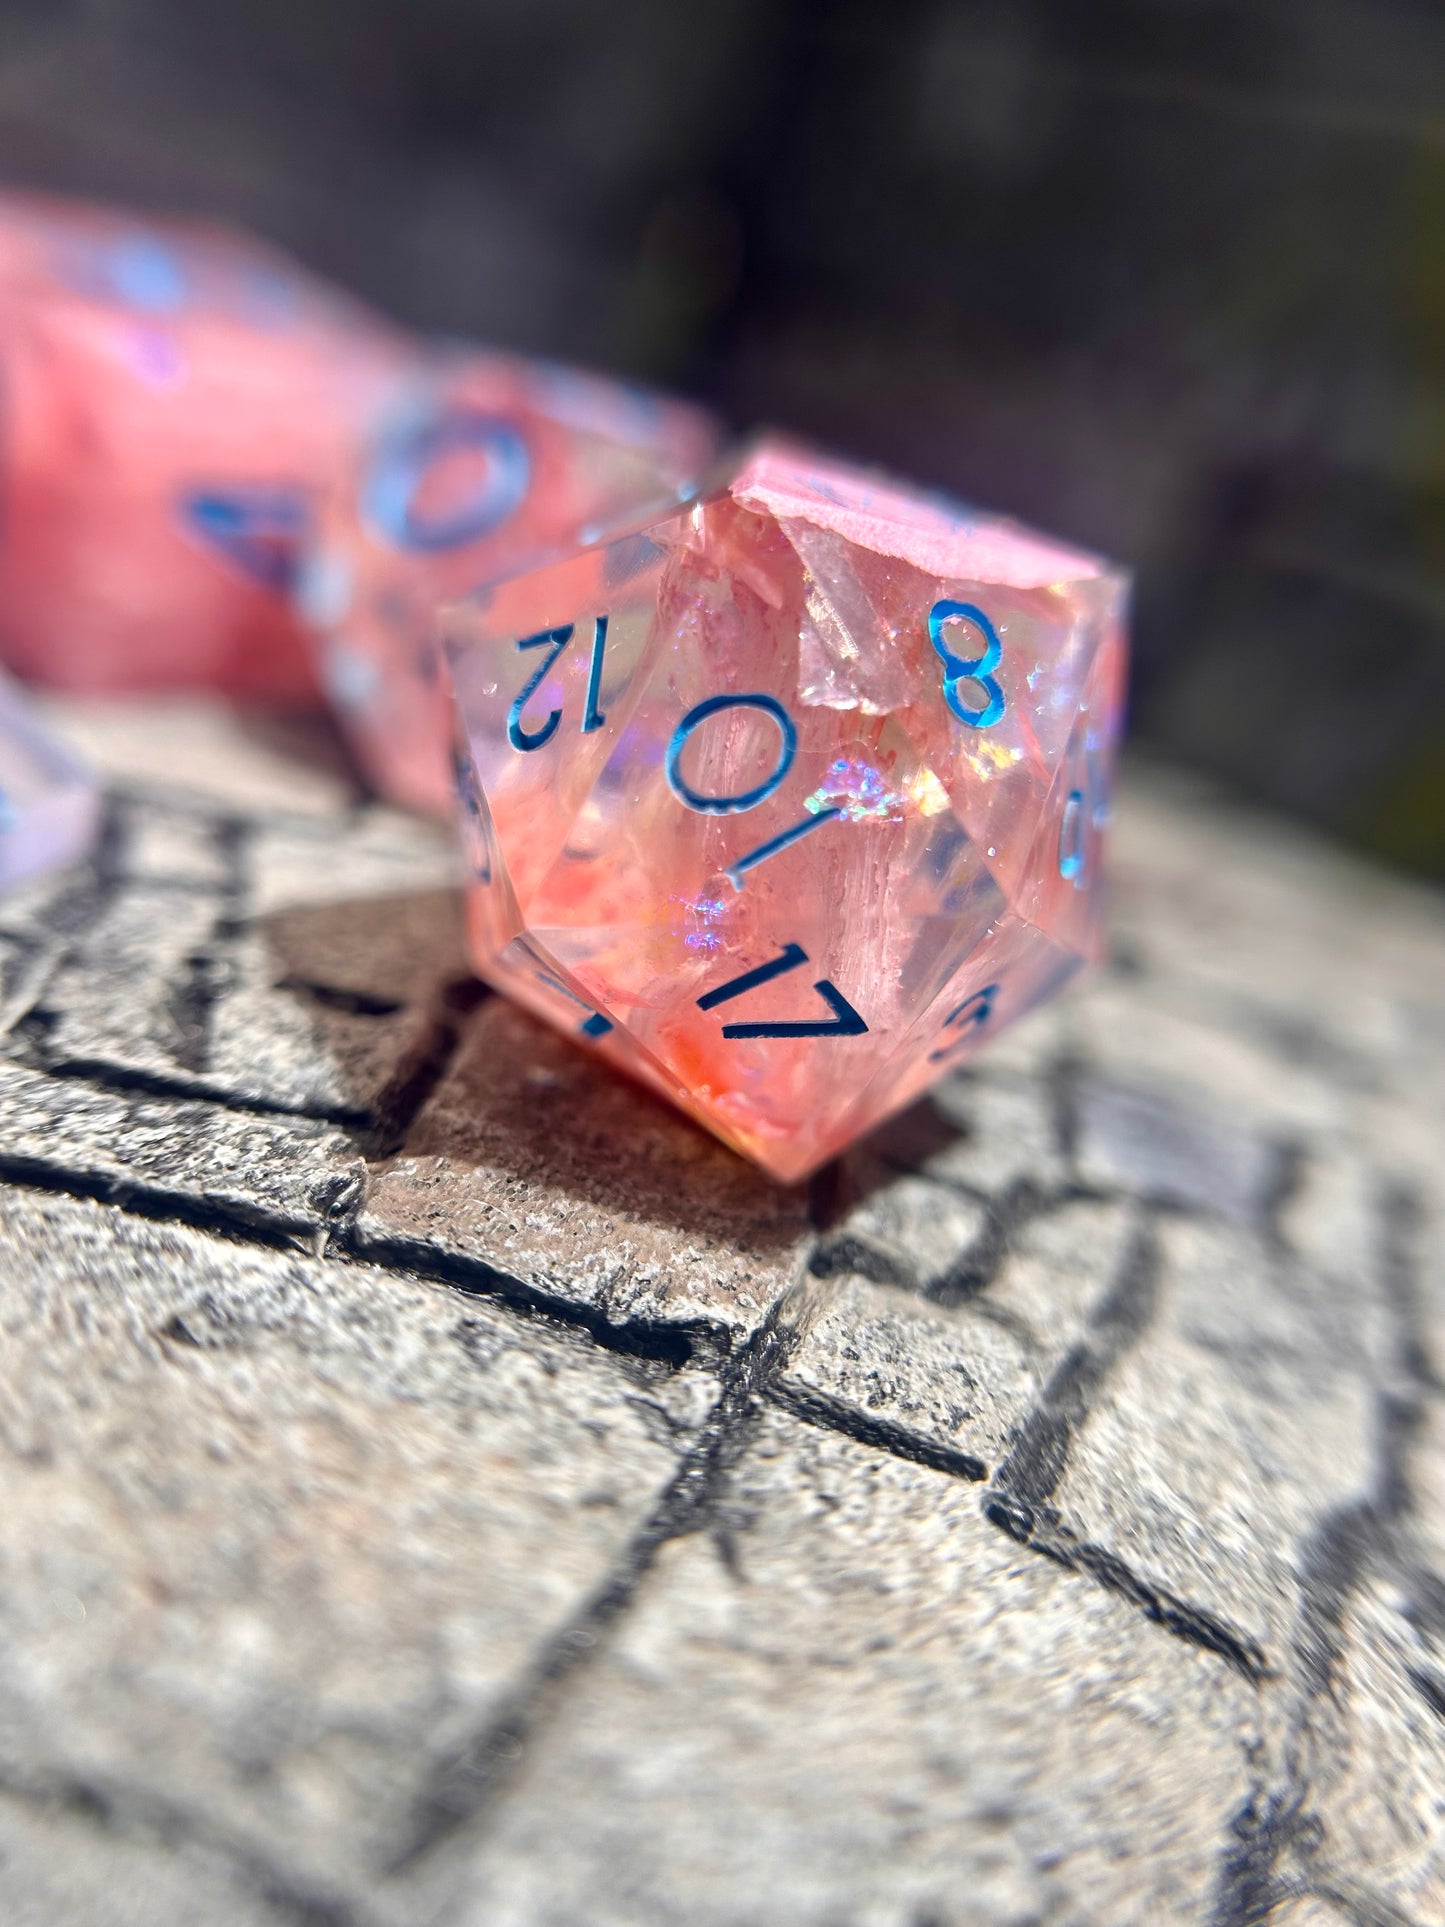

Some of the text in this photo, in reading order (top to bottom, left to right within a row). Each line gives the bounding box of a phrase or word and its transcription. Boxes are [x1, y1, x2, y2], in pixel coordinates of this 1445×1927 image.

[506, 613, 610, 754] 12
[927, 599, 1006, 729] 8
[696, 942, 870, 1040] 17
